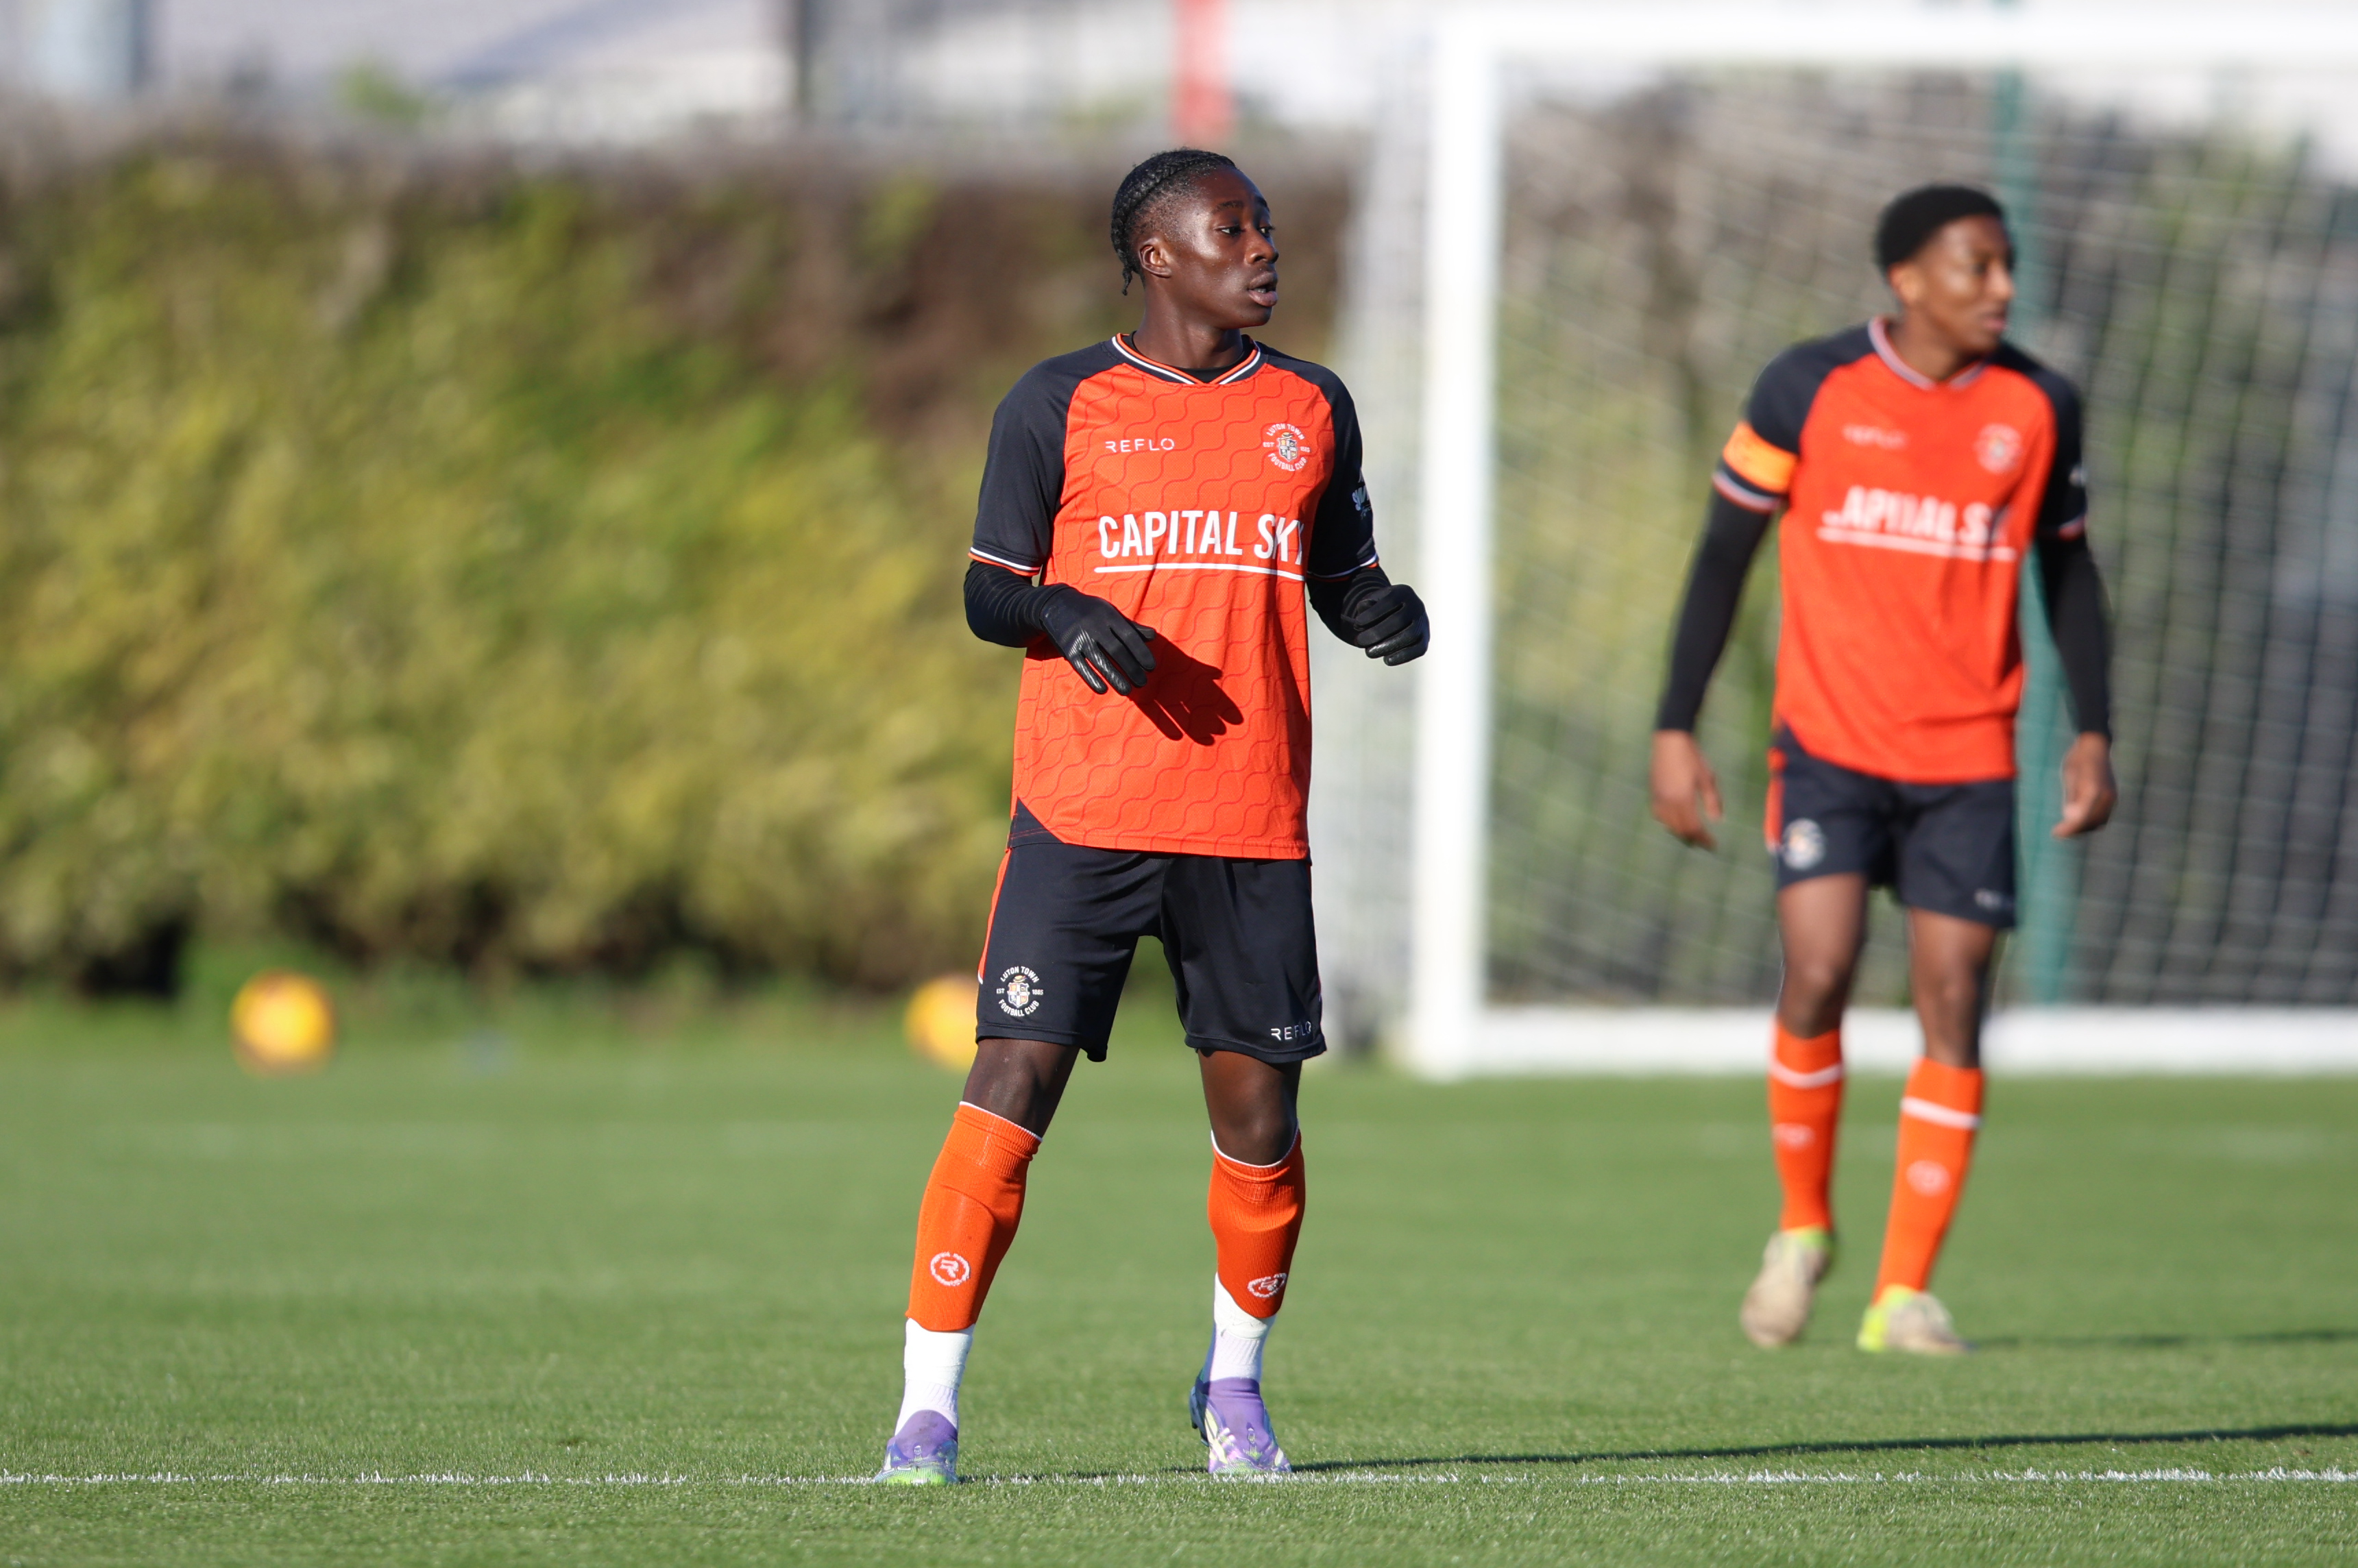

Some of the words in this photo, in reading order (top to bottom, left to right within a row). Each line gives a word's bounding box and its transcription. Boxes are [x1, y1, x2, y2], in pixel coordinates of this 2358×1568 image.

[1267, 424, 1285, 436] LUTON
[1287, 424, 1305, 440] TOWN
[1105, 438, 1175, 453] REFLO
[1268, 453, 1295, 471] FOOTBALL
[1294, 457, 1306, 469] CLUB
[1098, 510, 1243, 559] CAPITAL
[1000, 966, 1019, 982] LUTON
[1021, 966, 1040, 983] TOWN
[998, 999, 1025, 1017] FOOTBALL
[1025, 1000, 1040, 1015] CLUB
[1270, 1021, 1311, 1041] REFLO
